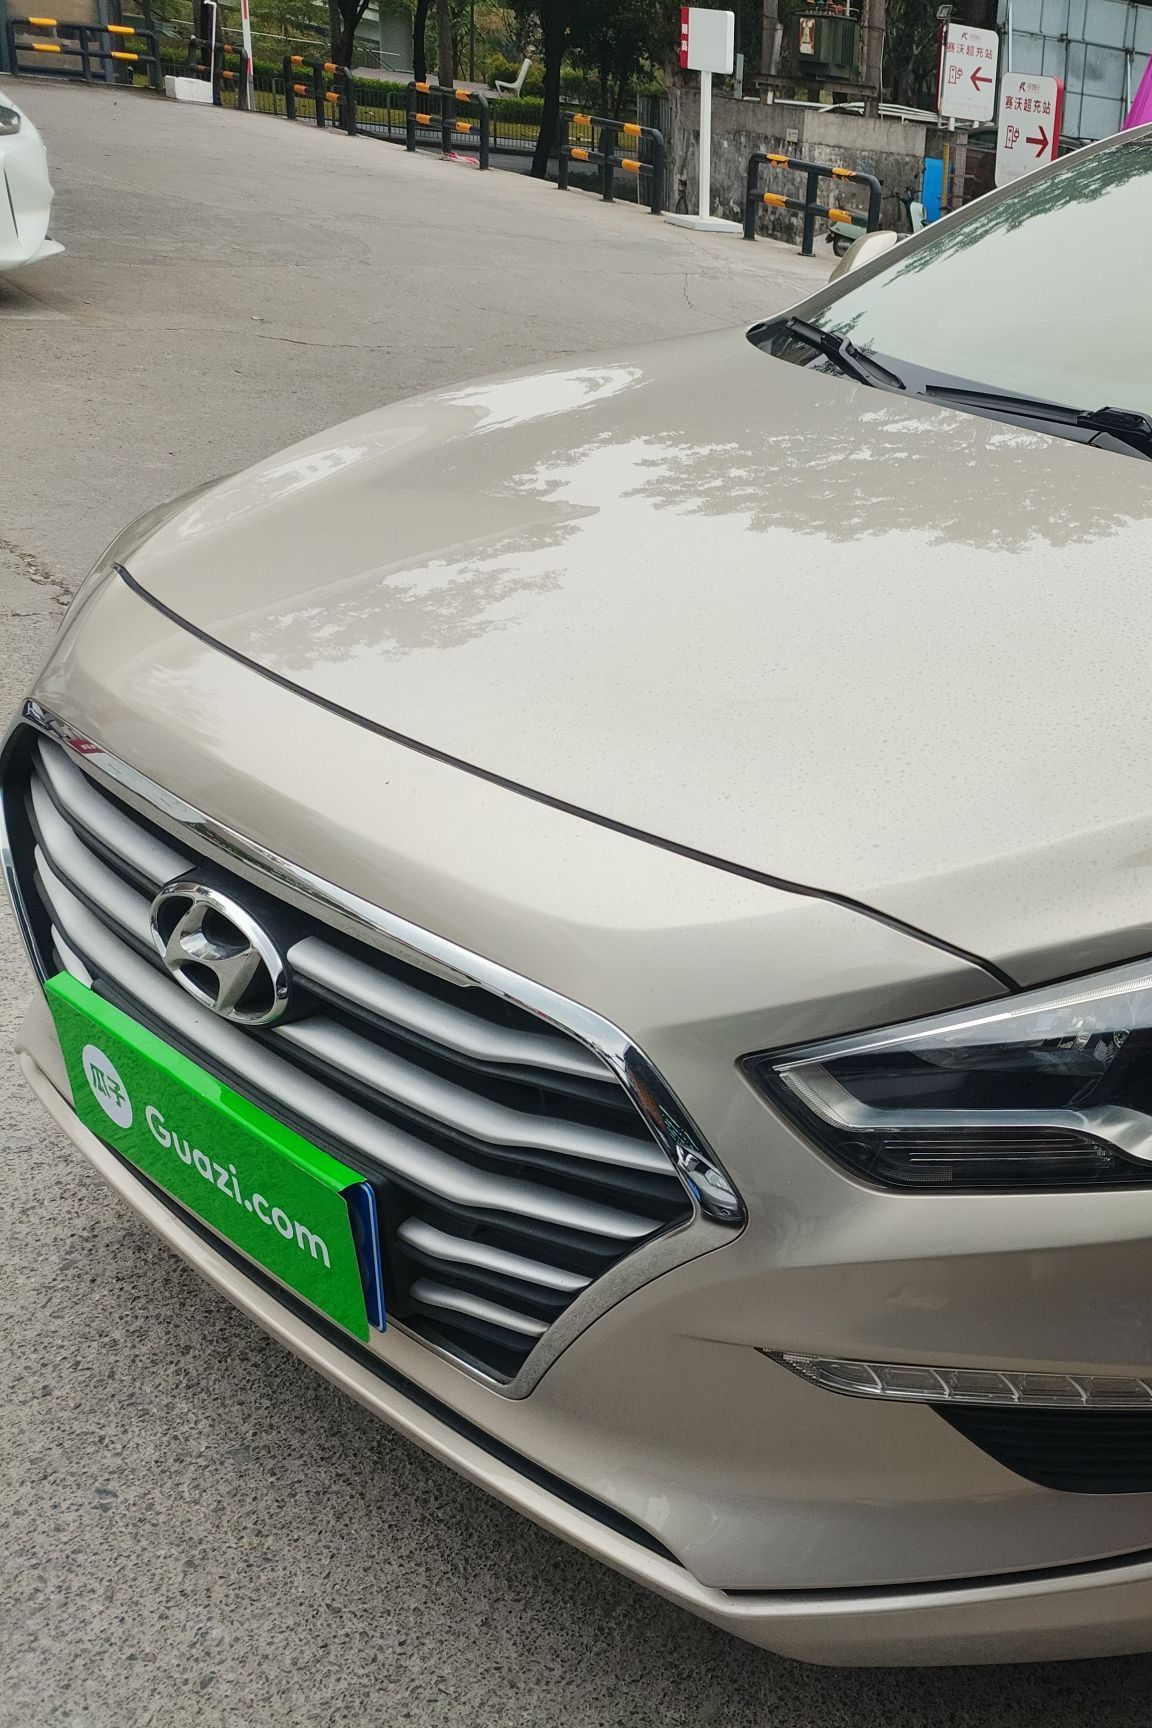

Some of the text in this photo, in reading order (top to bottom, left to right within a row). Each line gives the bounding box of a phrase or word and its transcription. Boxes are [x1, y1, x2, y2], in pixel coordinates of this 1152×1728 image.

[1005, 95, 1051, 116] 赛沃超充站
[90, 1062, 126, 1109] 瓜子
[145, 1105, 332, 1269] Guazi.com
